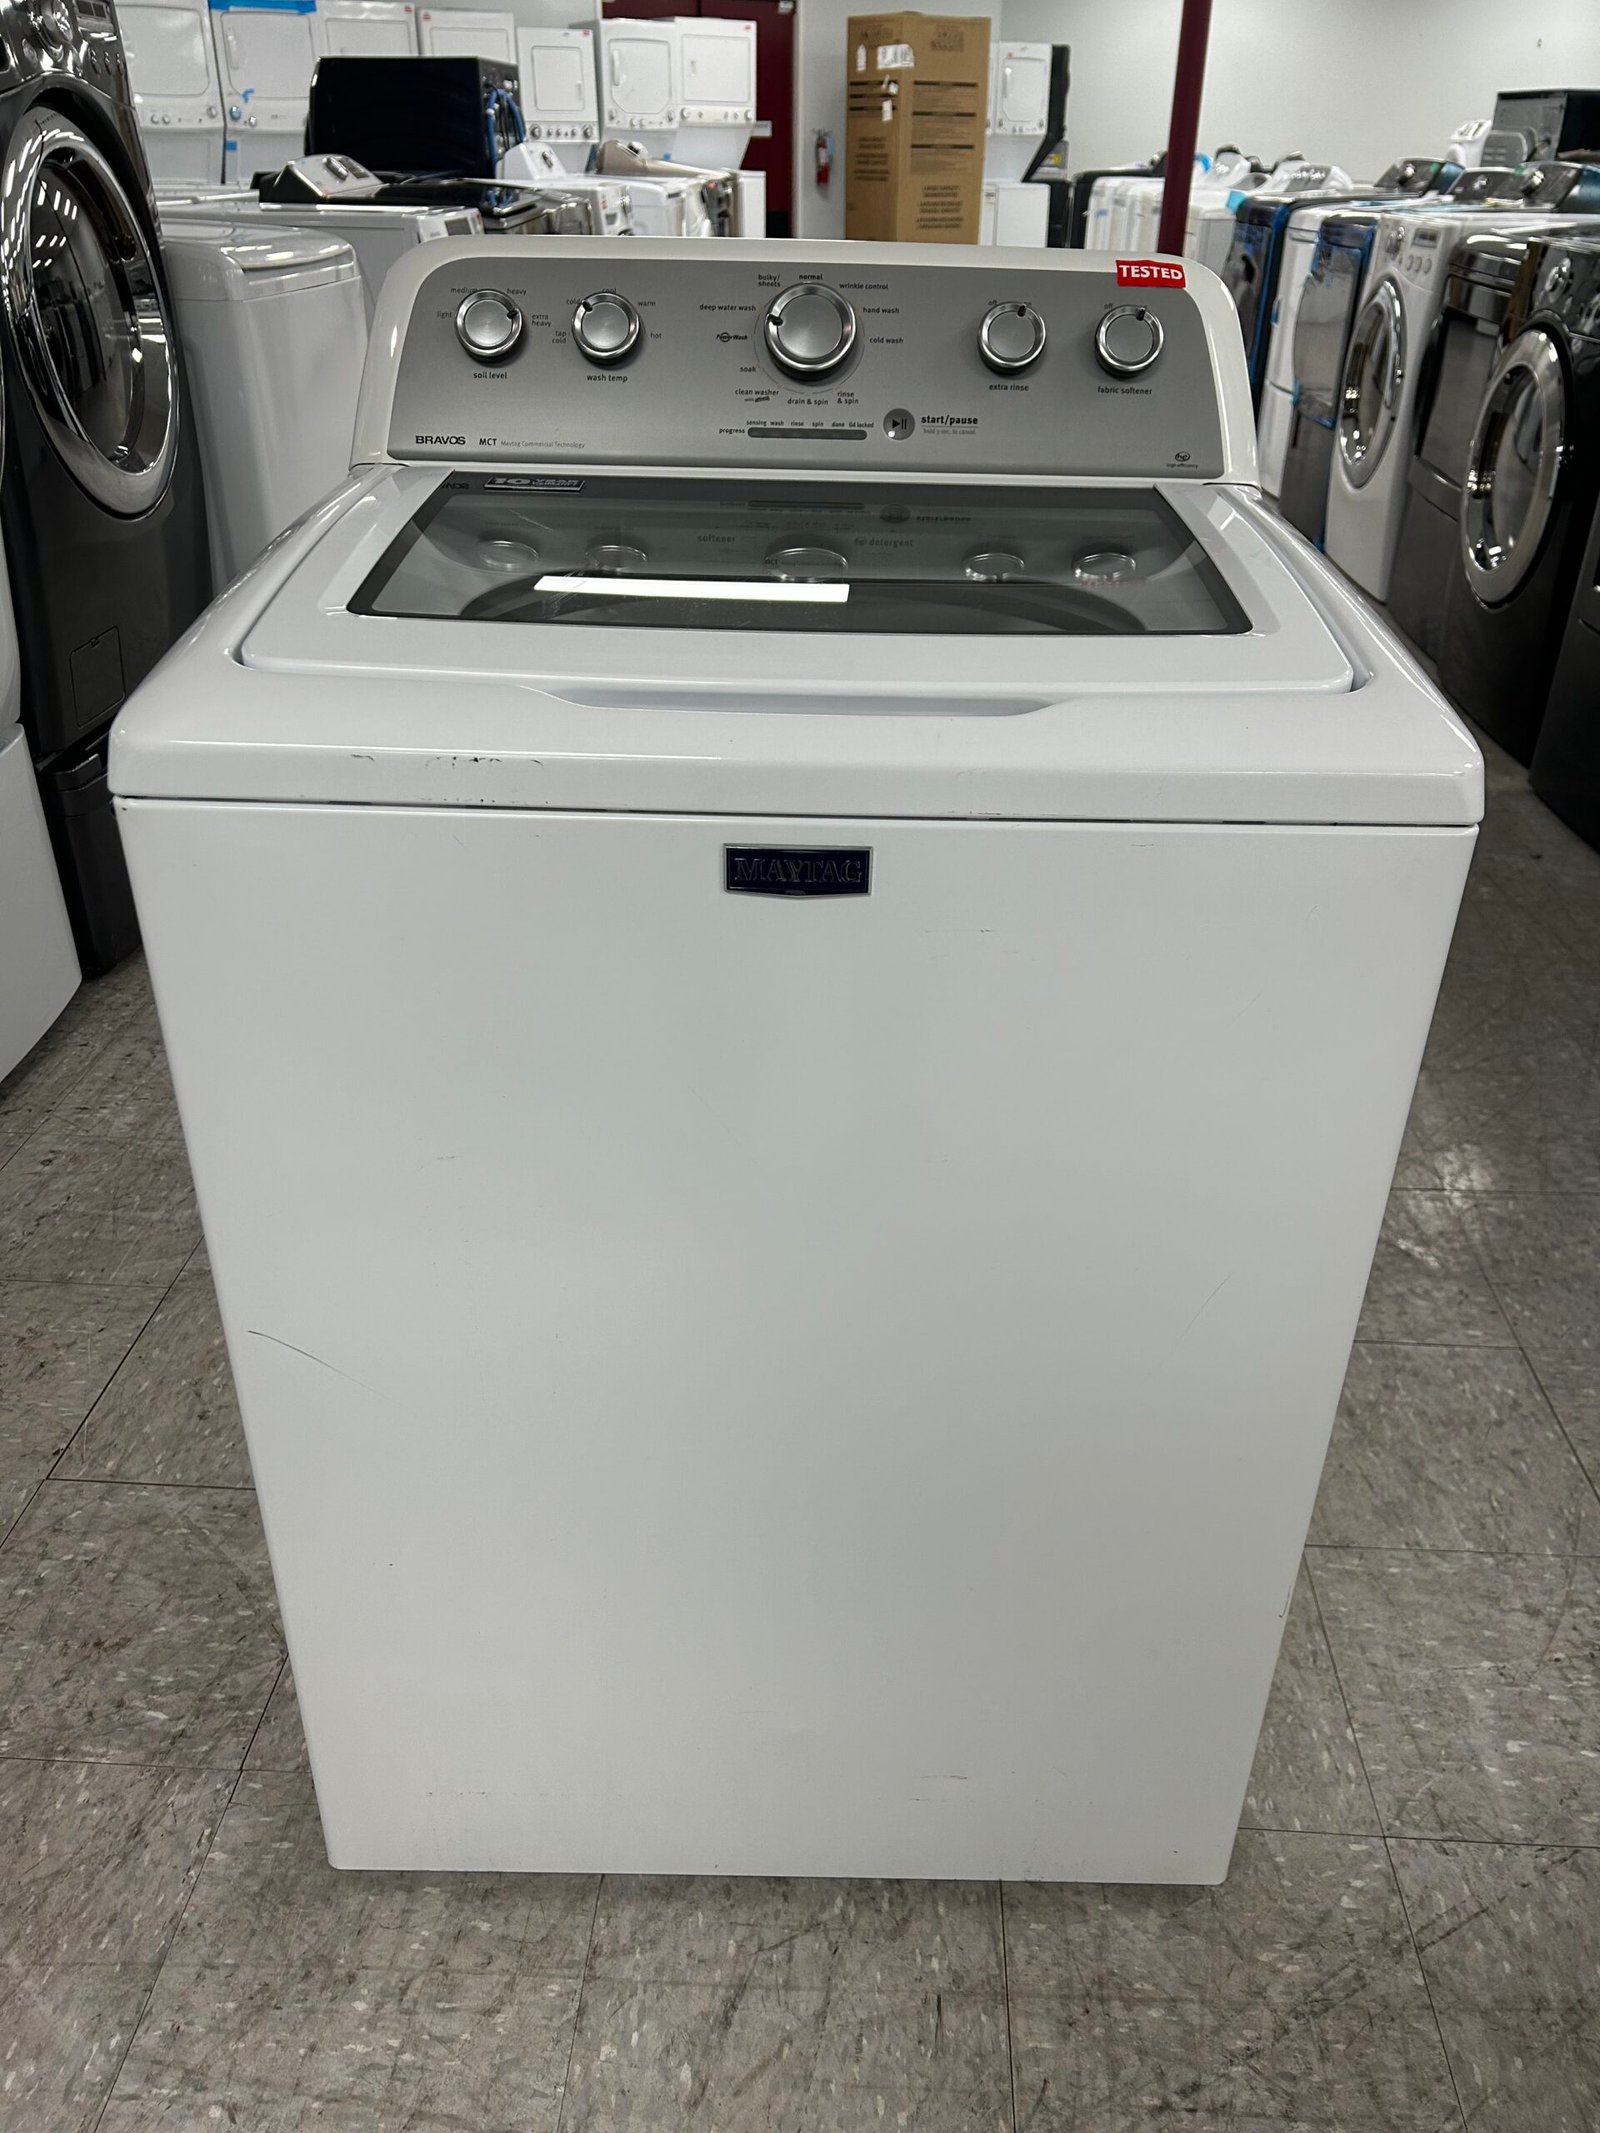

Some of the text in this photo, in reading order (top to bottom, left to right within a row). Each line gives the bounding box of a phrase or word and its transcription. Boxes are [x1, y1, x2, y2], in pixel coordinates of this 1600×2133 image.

[1118, 264, 1183, 280] TESTED
[758, 273, 780, 281] bulky/
[798, 273, 823, 281] normal
[507, 288, 527, 296] heavy
[437, 311, 452, 319] light
[531, 320, 551, 328] heavy
[555, 330, 567, 338] tap
[739, 365, 756, 373] soak
[473, 371, 508, 380] soil level
[586, 374, 628, 383] wash temp
[988, 383, 1030, 392] extra rinse
[1097, 386, 1153, 395] fabric softener
[813, 398, 829, 406] spin
[921, 414, 978, 426] start/pause
[719, 427, 745, 435] progress
[415, 435, 466, 446] BRAVOS
[479, 438, 498, 446] MCT
[555, 441, 585, 449] Technology
[494, 477, 531, 485] 10
[697, 534, 735, 543] softener
[868, 537, 913, 548] detergent
[734, 857, 862, 883] MAYTAG
